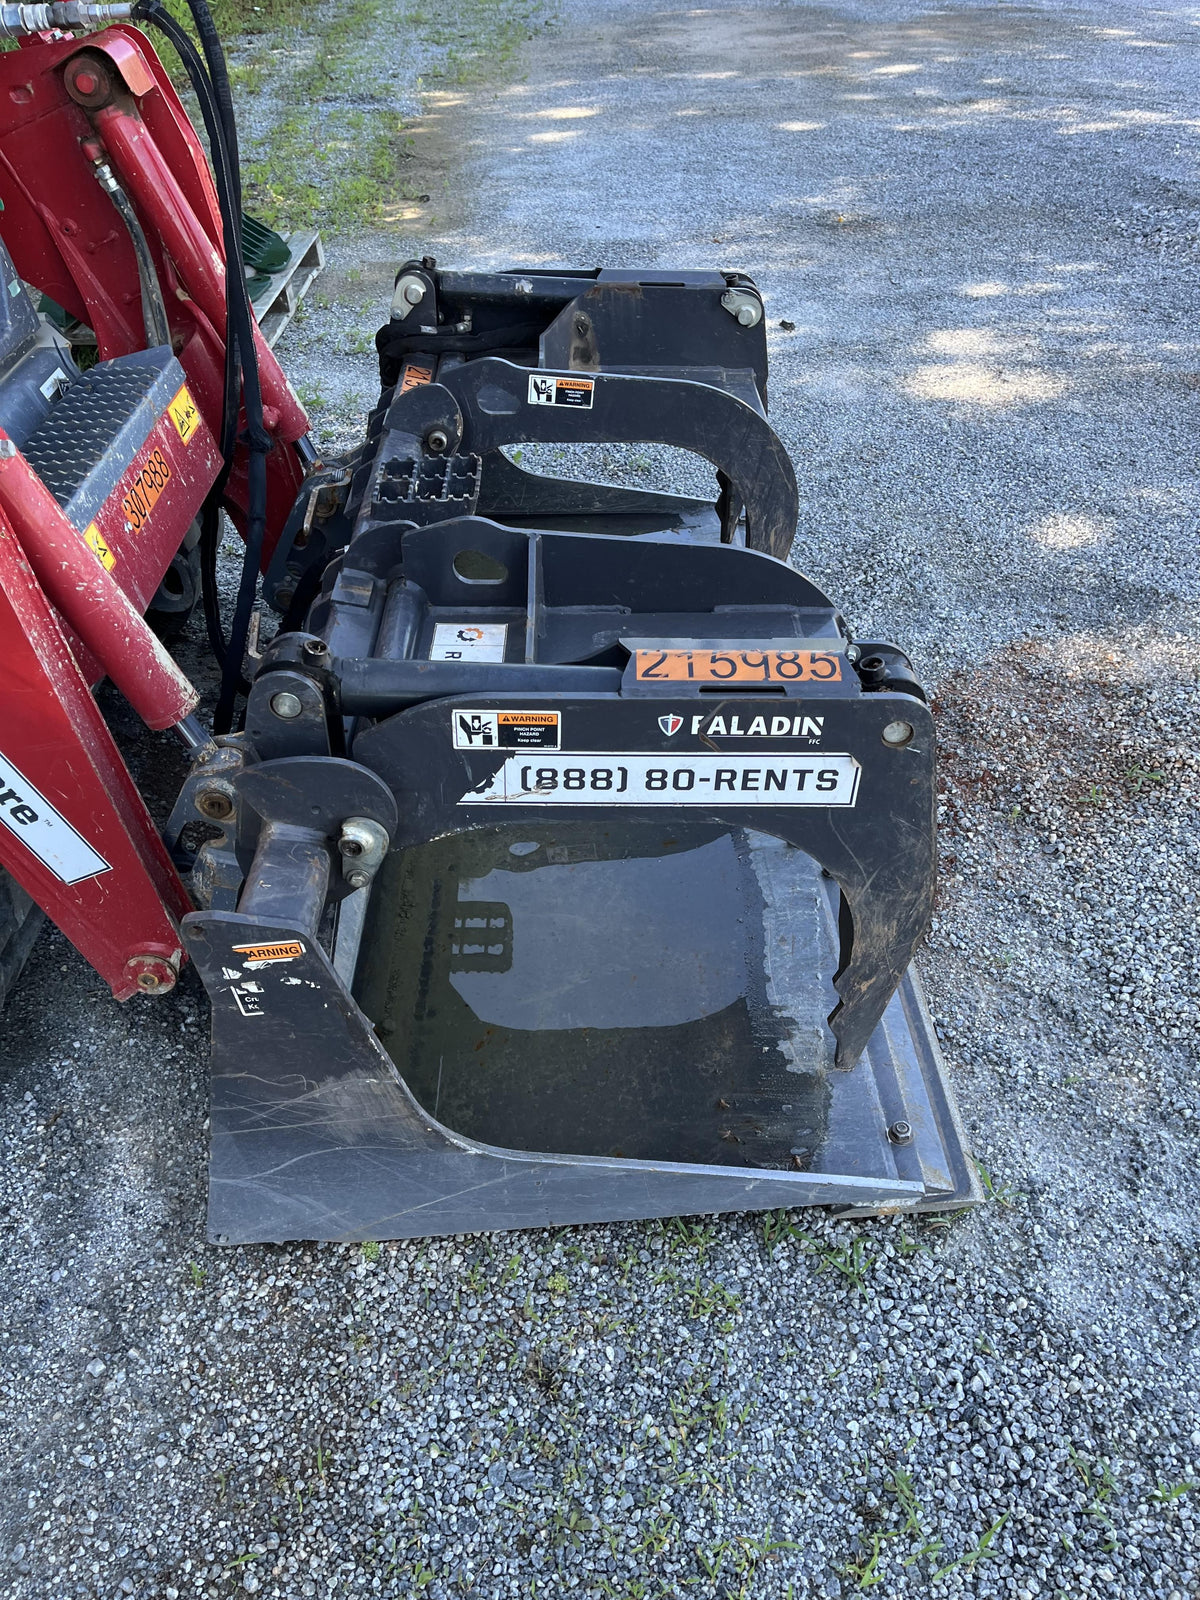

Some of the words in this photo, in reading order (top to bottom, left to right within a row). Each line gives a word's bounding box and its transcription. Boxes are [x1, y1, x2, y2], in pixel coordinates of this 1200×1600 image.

[564, 381, 590, 389] WARNING
[123, 450, 169, 529] 307988
[641, 650, 837, 679] 215985
[691, 715, 825, 736] PALADIN
[520, 766, 629, 793] (888)
[645, 768, 840, 792] 80-RENTS
[0, 777, 39, 826] re
[249, 946, 299, 958] ARNING
